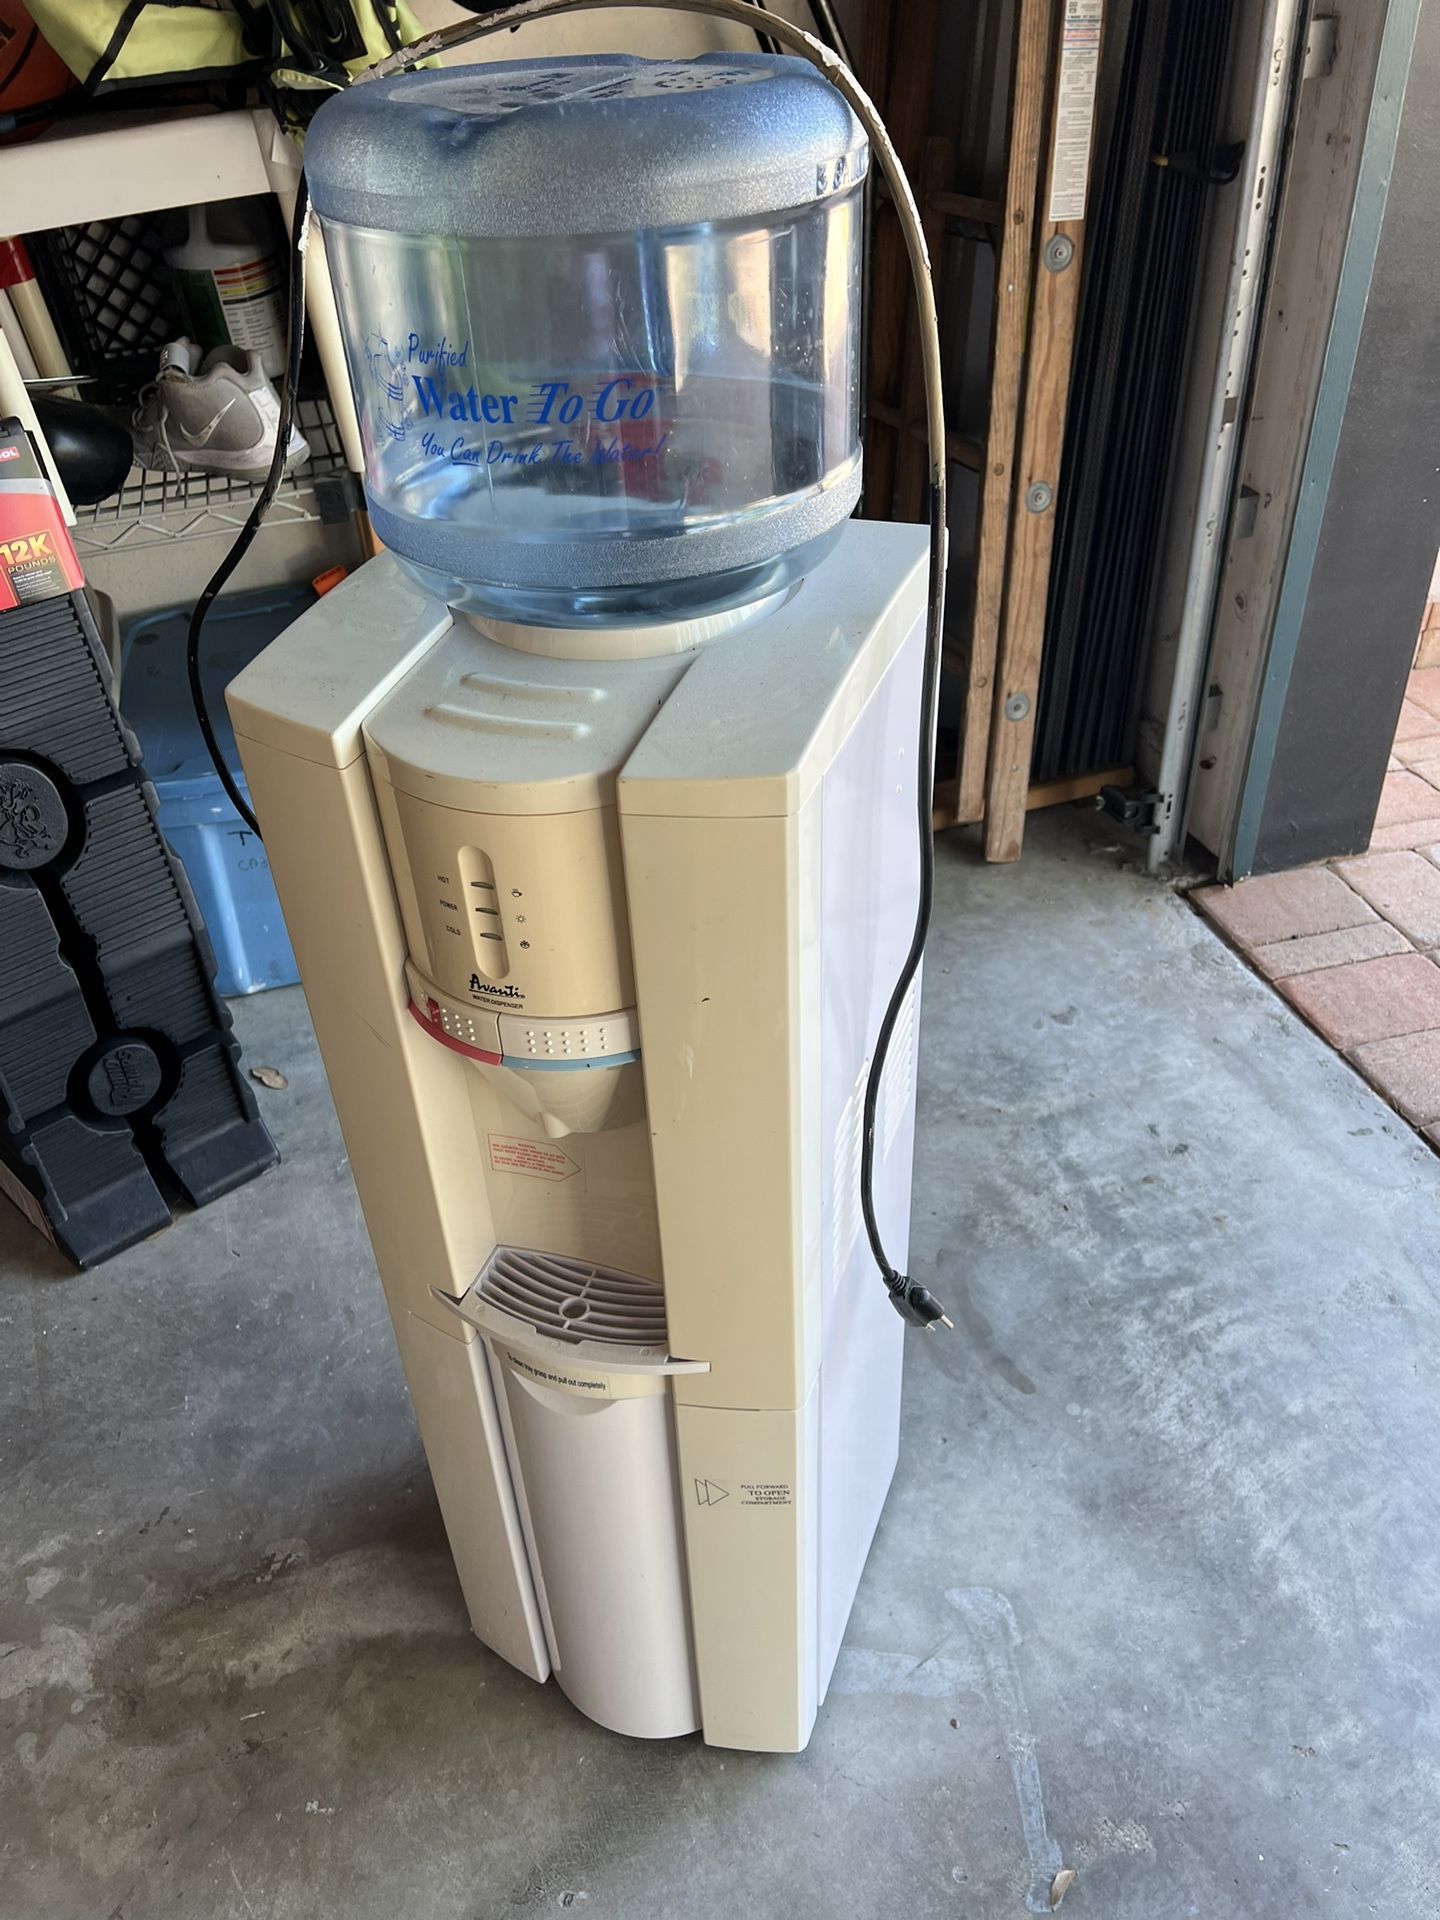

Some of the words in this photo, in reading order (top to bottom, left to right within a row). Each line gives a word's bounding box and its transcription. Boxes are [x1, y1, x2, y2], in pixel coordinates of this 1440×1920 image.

[407, 332, 469, 370] Purified
[411, 375, 519, 424] Water
[528, 381, 584, 425] To
[592, 377, 656, 424] Go
[421, 432, 446, 458] You
[450, 436, 481, 463] Can
[486, 440, 544, 465] Drink
[550, 439, 584, 466] The
[592, 433, 668, 465] Water!
[0, 533, 54, 566] 12K
[7, 556, 58, 575] POUNDS
[437, 875, 449, 884] HOT
[439, 899, 458, 910] POWER
[446, 925, 461, 936] COLD
[468, 973, 520, 998] Avanti
[472, 994, 490, 1004] WATER
[491, 999, 524, 1009] DISPENSER
[534, 1368, 547, 1379] grasp
[548, 1374, 557, 1383] and
[577, 1380, 605, 1391] completely
